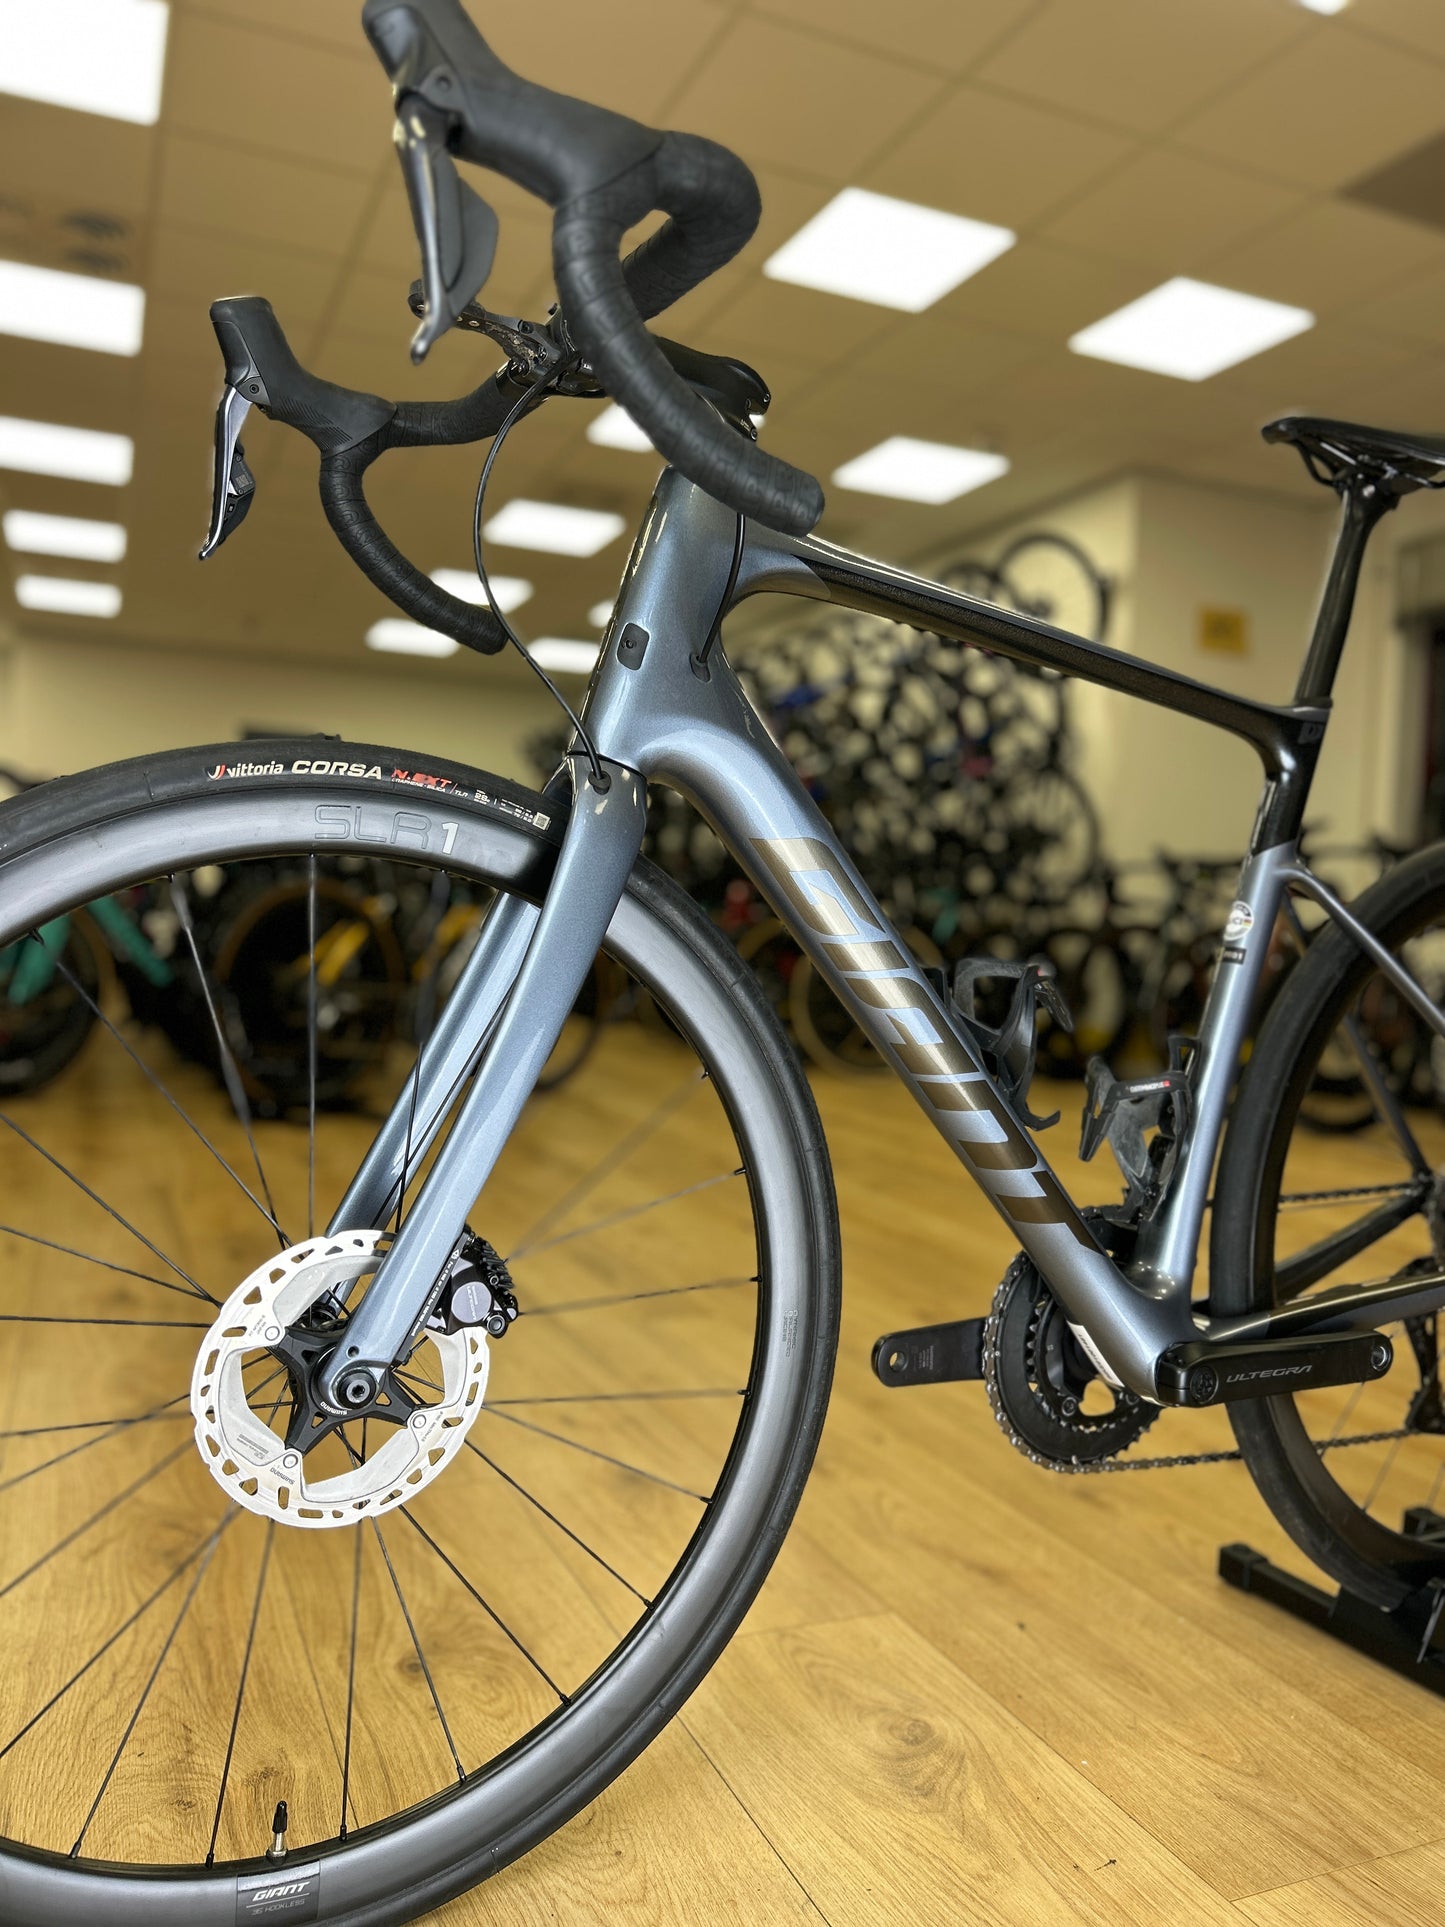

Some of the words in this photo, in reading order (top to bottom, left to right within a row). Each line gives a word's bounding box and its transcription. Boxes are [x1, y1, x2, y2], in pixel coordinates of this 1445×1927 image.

[226, 760, 284, 778] vittoria
[292, 760, 382, 781] CORSA
[749, 837, 1110, 1258] GIANT
[1226, 1365, 1312, 1383] ULTEGRA
[320, 1401, 347, 1416] SHIMANO
[252, 1881, 311, 1902] GIANT
